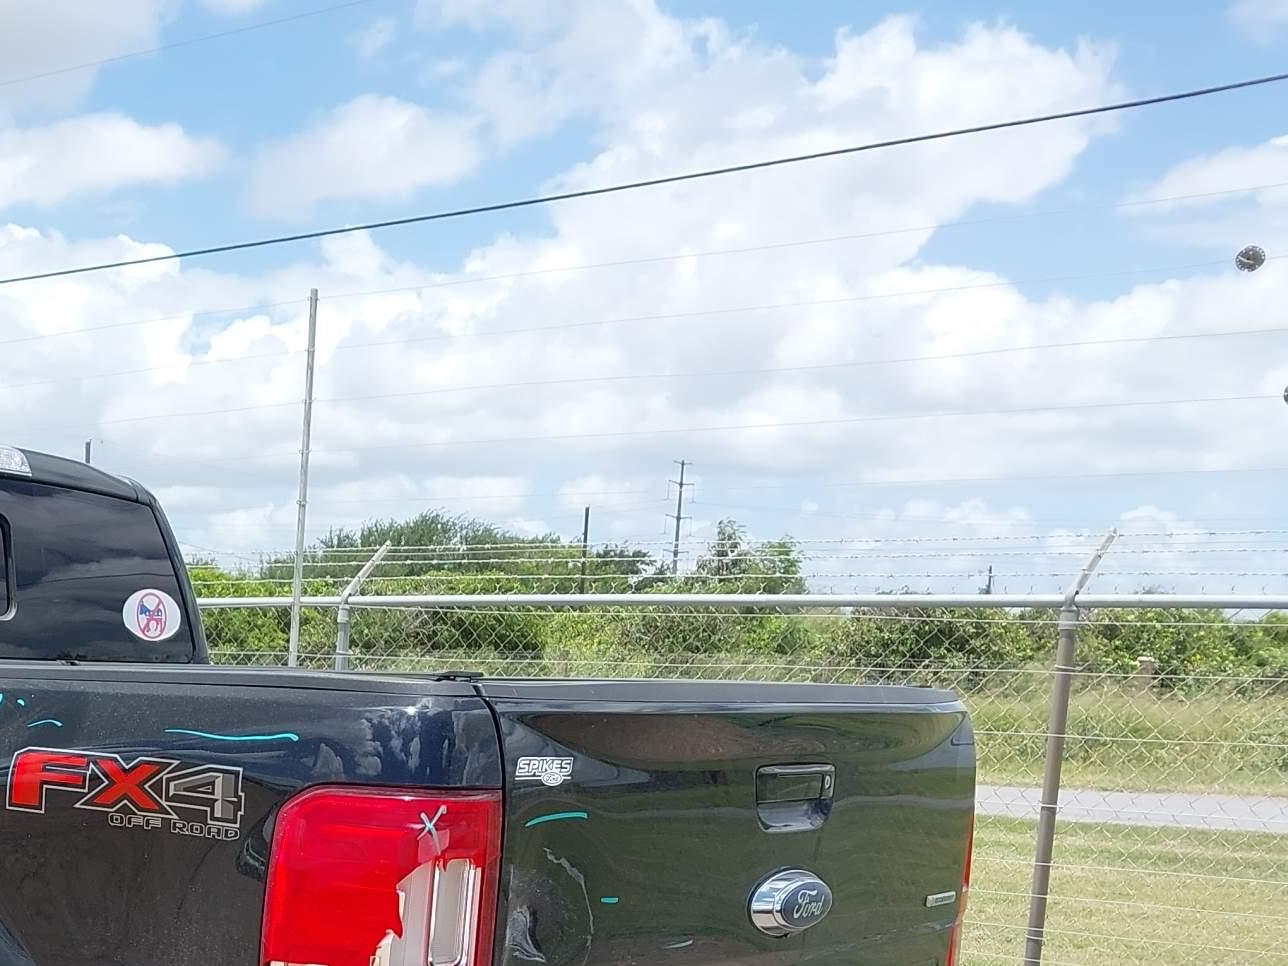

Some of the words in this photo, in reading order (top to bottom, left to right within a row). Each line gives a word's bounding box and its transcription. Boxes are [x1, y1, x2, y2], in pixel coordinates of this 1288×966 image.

[518, 759, 571, 773] SPIKES
[5, 747, 245, 828] FX4
[108, 813, 162, 830] OFF
[170, 819, 240, 841] ROAD
[793, 889, 825, 919] Ford
